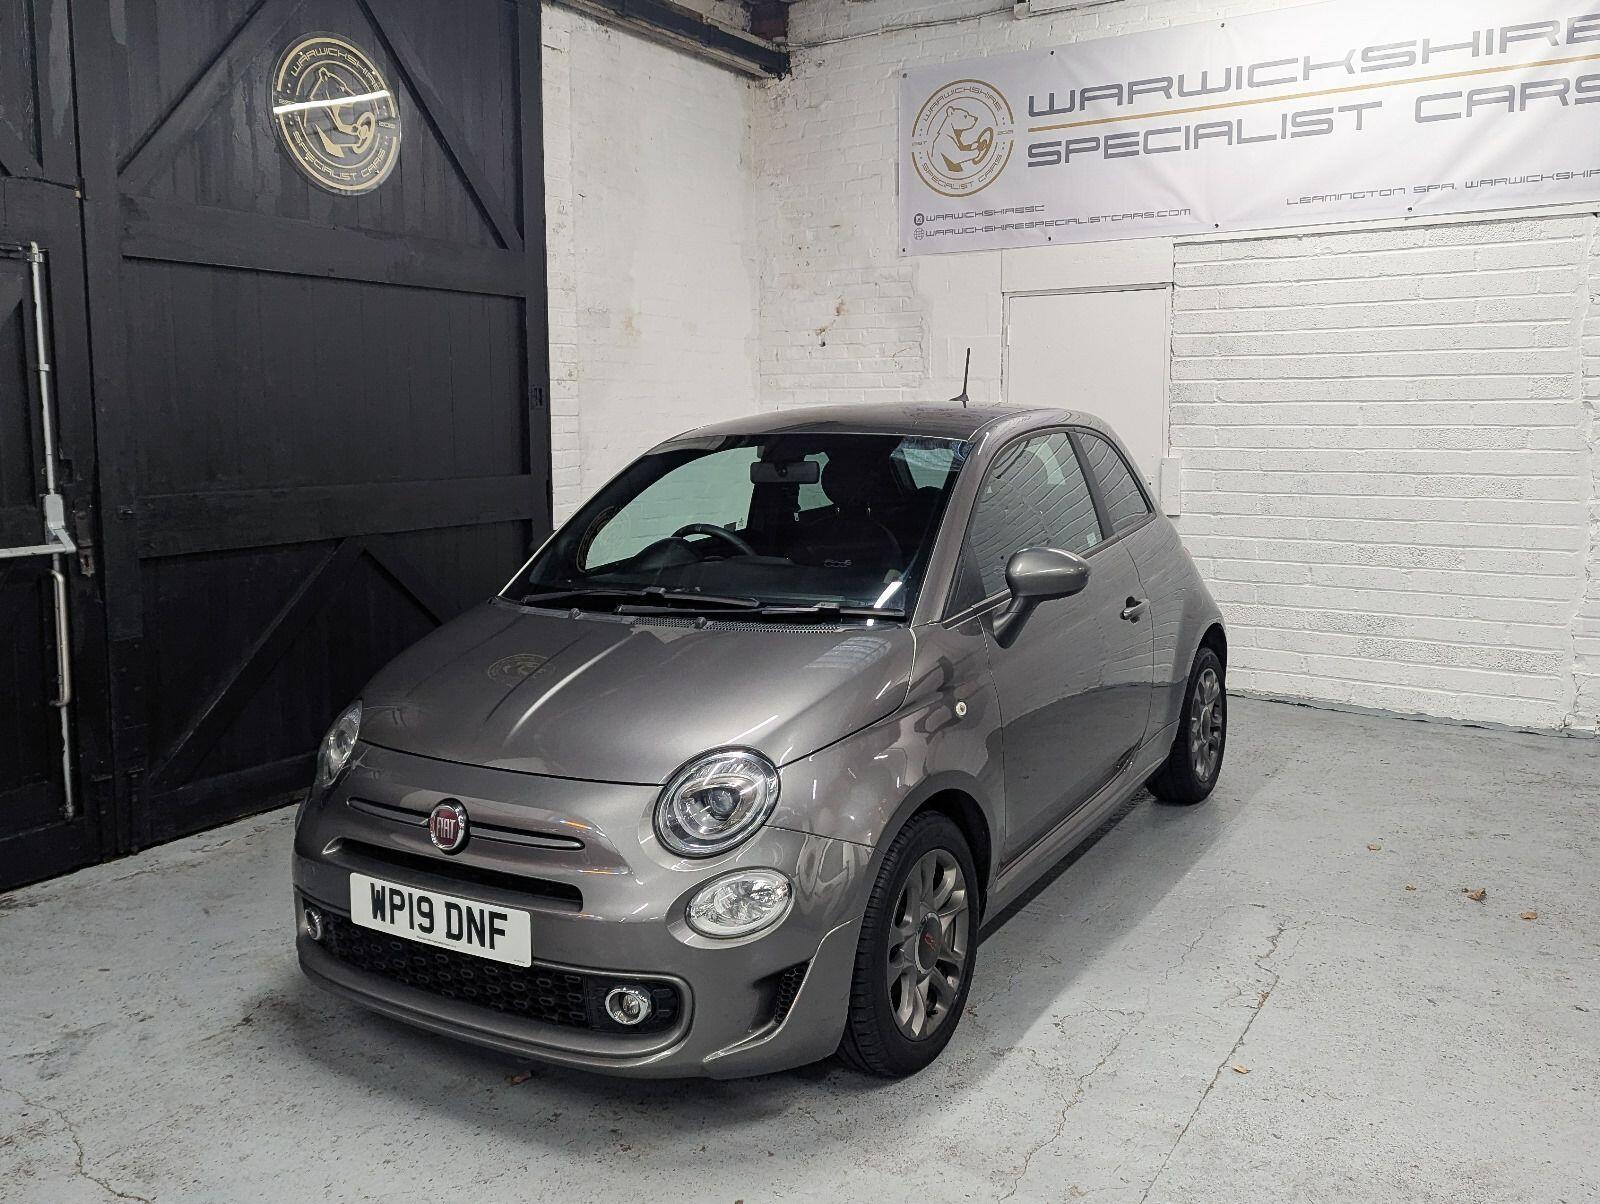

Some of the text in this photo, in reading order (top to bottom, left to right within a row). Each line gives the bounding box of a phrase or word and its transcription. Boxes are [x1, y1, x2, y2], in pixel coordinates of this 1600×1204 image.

[1028, 13, 1600, 117] WARWICKSHIRE
[923, 86, 1003, 122] WARWICKSHIRE
[1028, 73, 1600, 168] SPECIALIST CARS
[292, 130, 386, 181] SPECIALIST CARS
[922, 153, 1003, 190] SPECIALIST CARS
[1286, 187, 1405, 205] LEAMINGTON
[925, 208, 1191, 238] WARWICKSHIRESPECIALISTCARS.COM
[436, 816, 456, 839] FIAT
[370, 883, 507, 950] WP19 DNF
